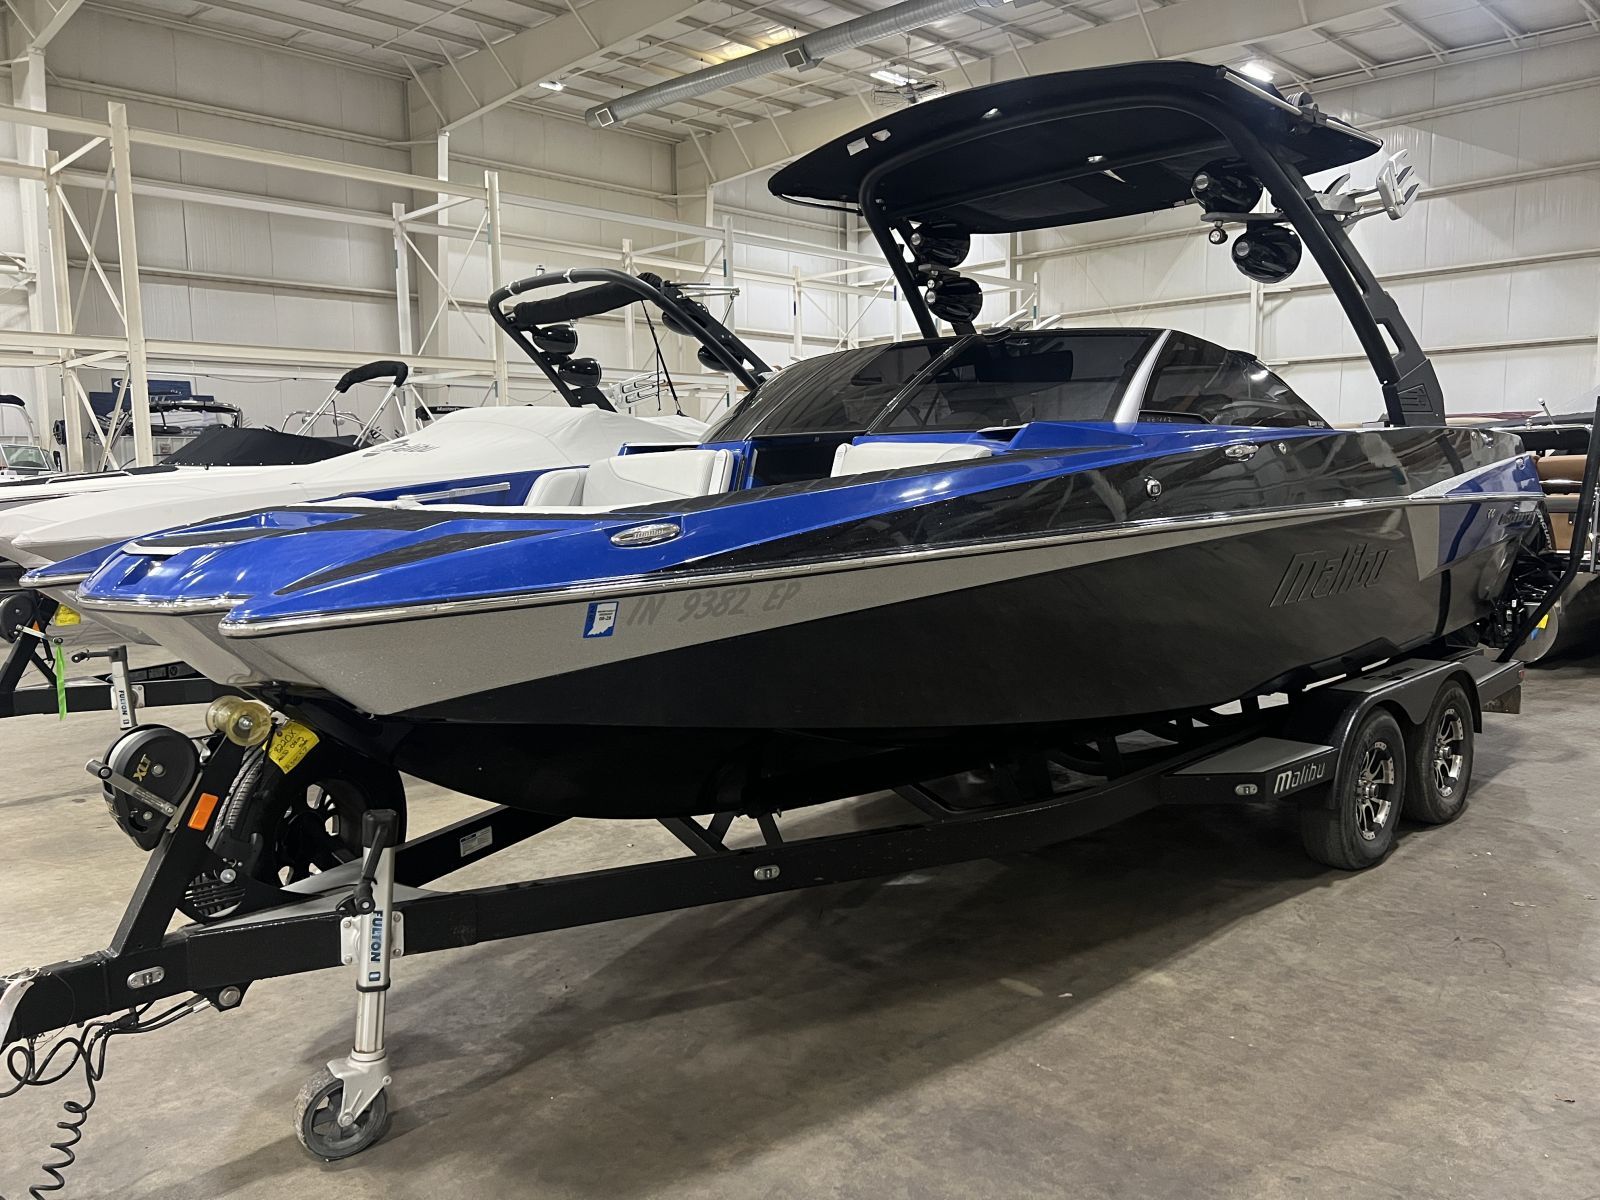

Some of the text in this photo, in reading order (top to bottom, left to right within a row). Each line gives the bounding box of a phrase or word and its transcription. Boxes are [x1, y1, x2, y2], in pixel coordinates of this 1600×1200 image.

[1269, 543, 1393, 607] Malibu
[627, 581, 801, 626] IN 9382 EP
[118, 690, 128, 716] FULTON
[1273, 762, 1326, 795] Malibu
[371, 910, 383, 962] FULTON
